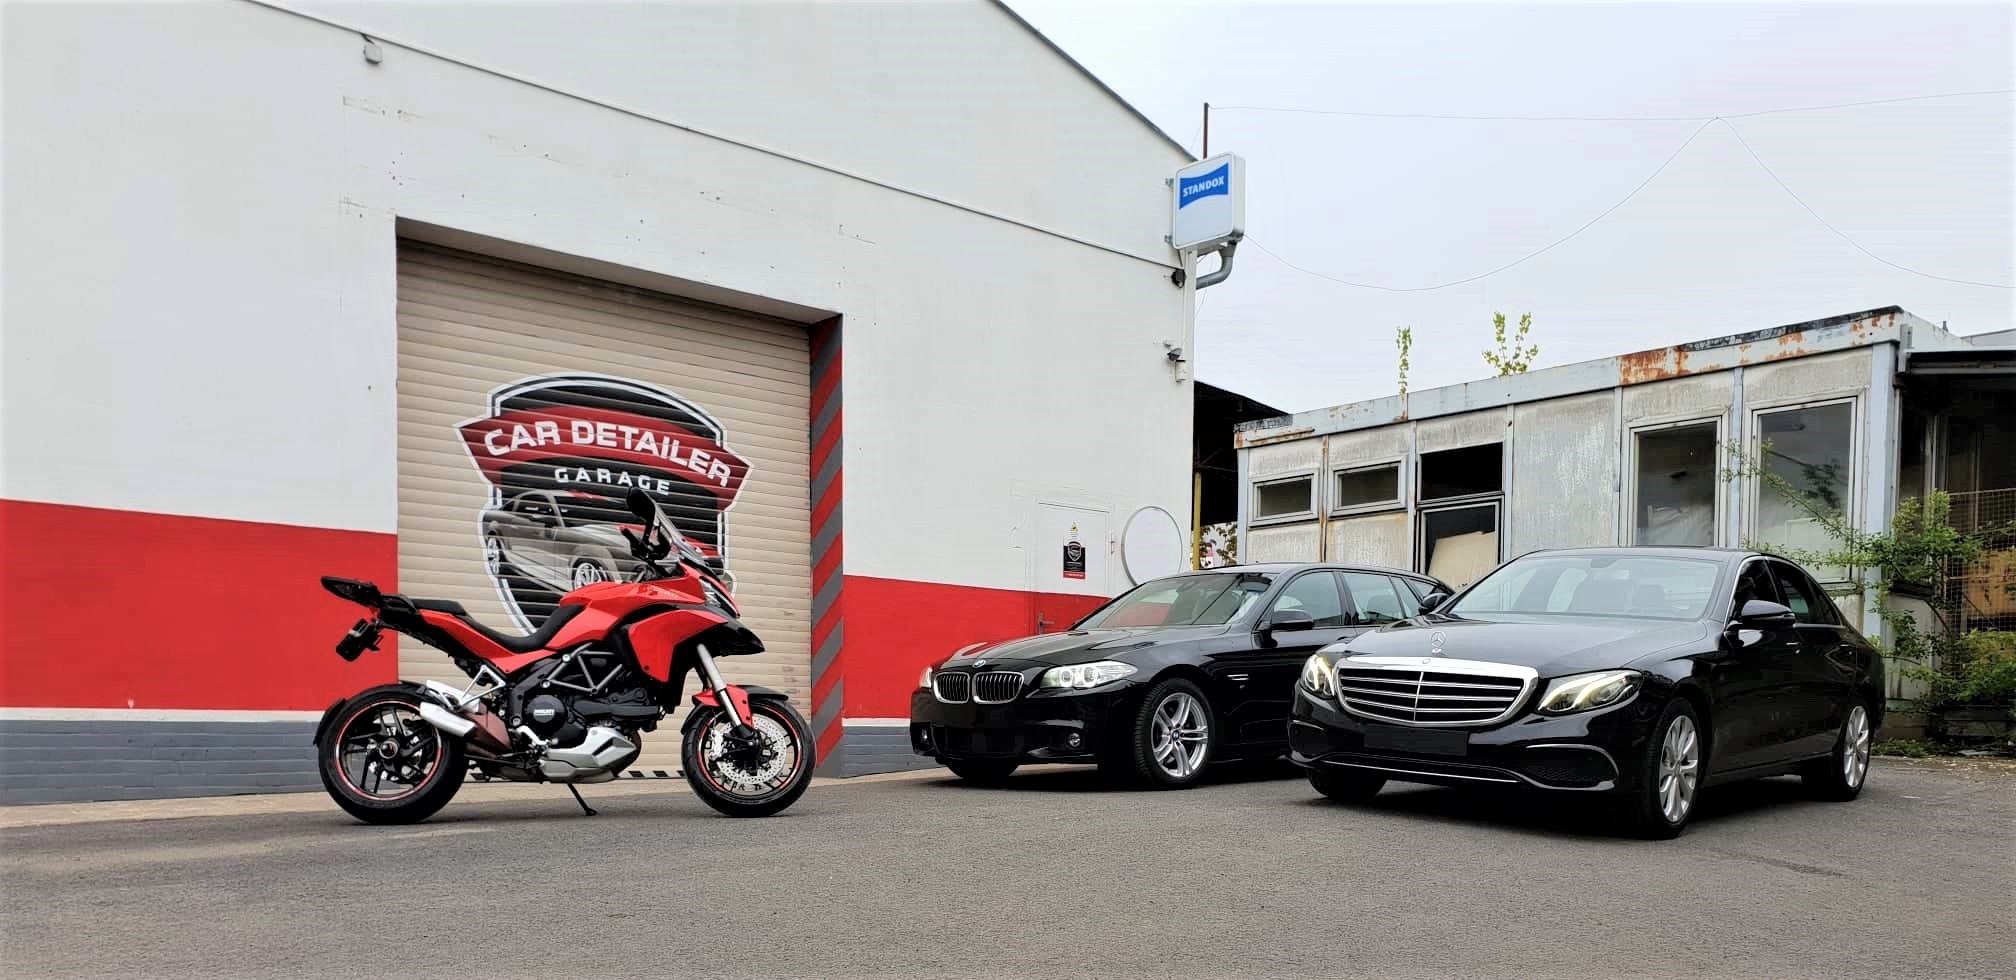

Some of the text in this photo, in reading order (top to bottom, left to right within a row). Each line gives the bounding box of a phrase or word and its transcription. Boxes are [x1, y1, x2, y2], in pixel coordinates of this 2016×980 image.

[1183, 176, 1225, 197] STANDOX
[484, 420, 732, 487] CAR DETAILER
[554, 467, 670, 495] GARAGE
